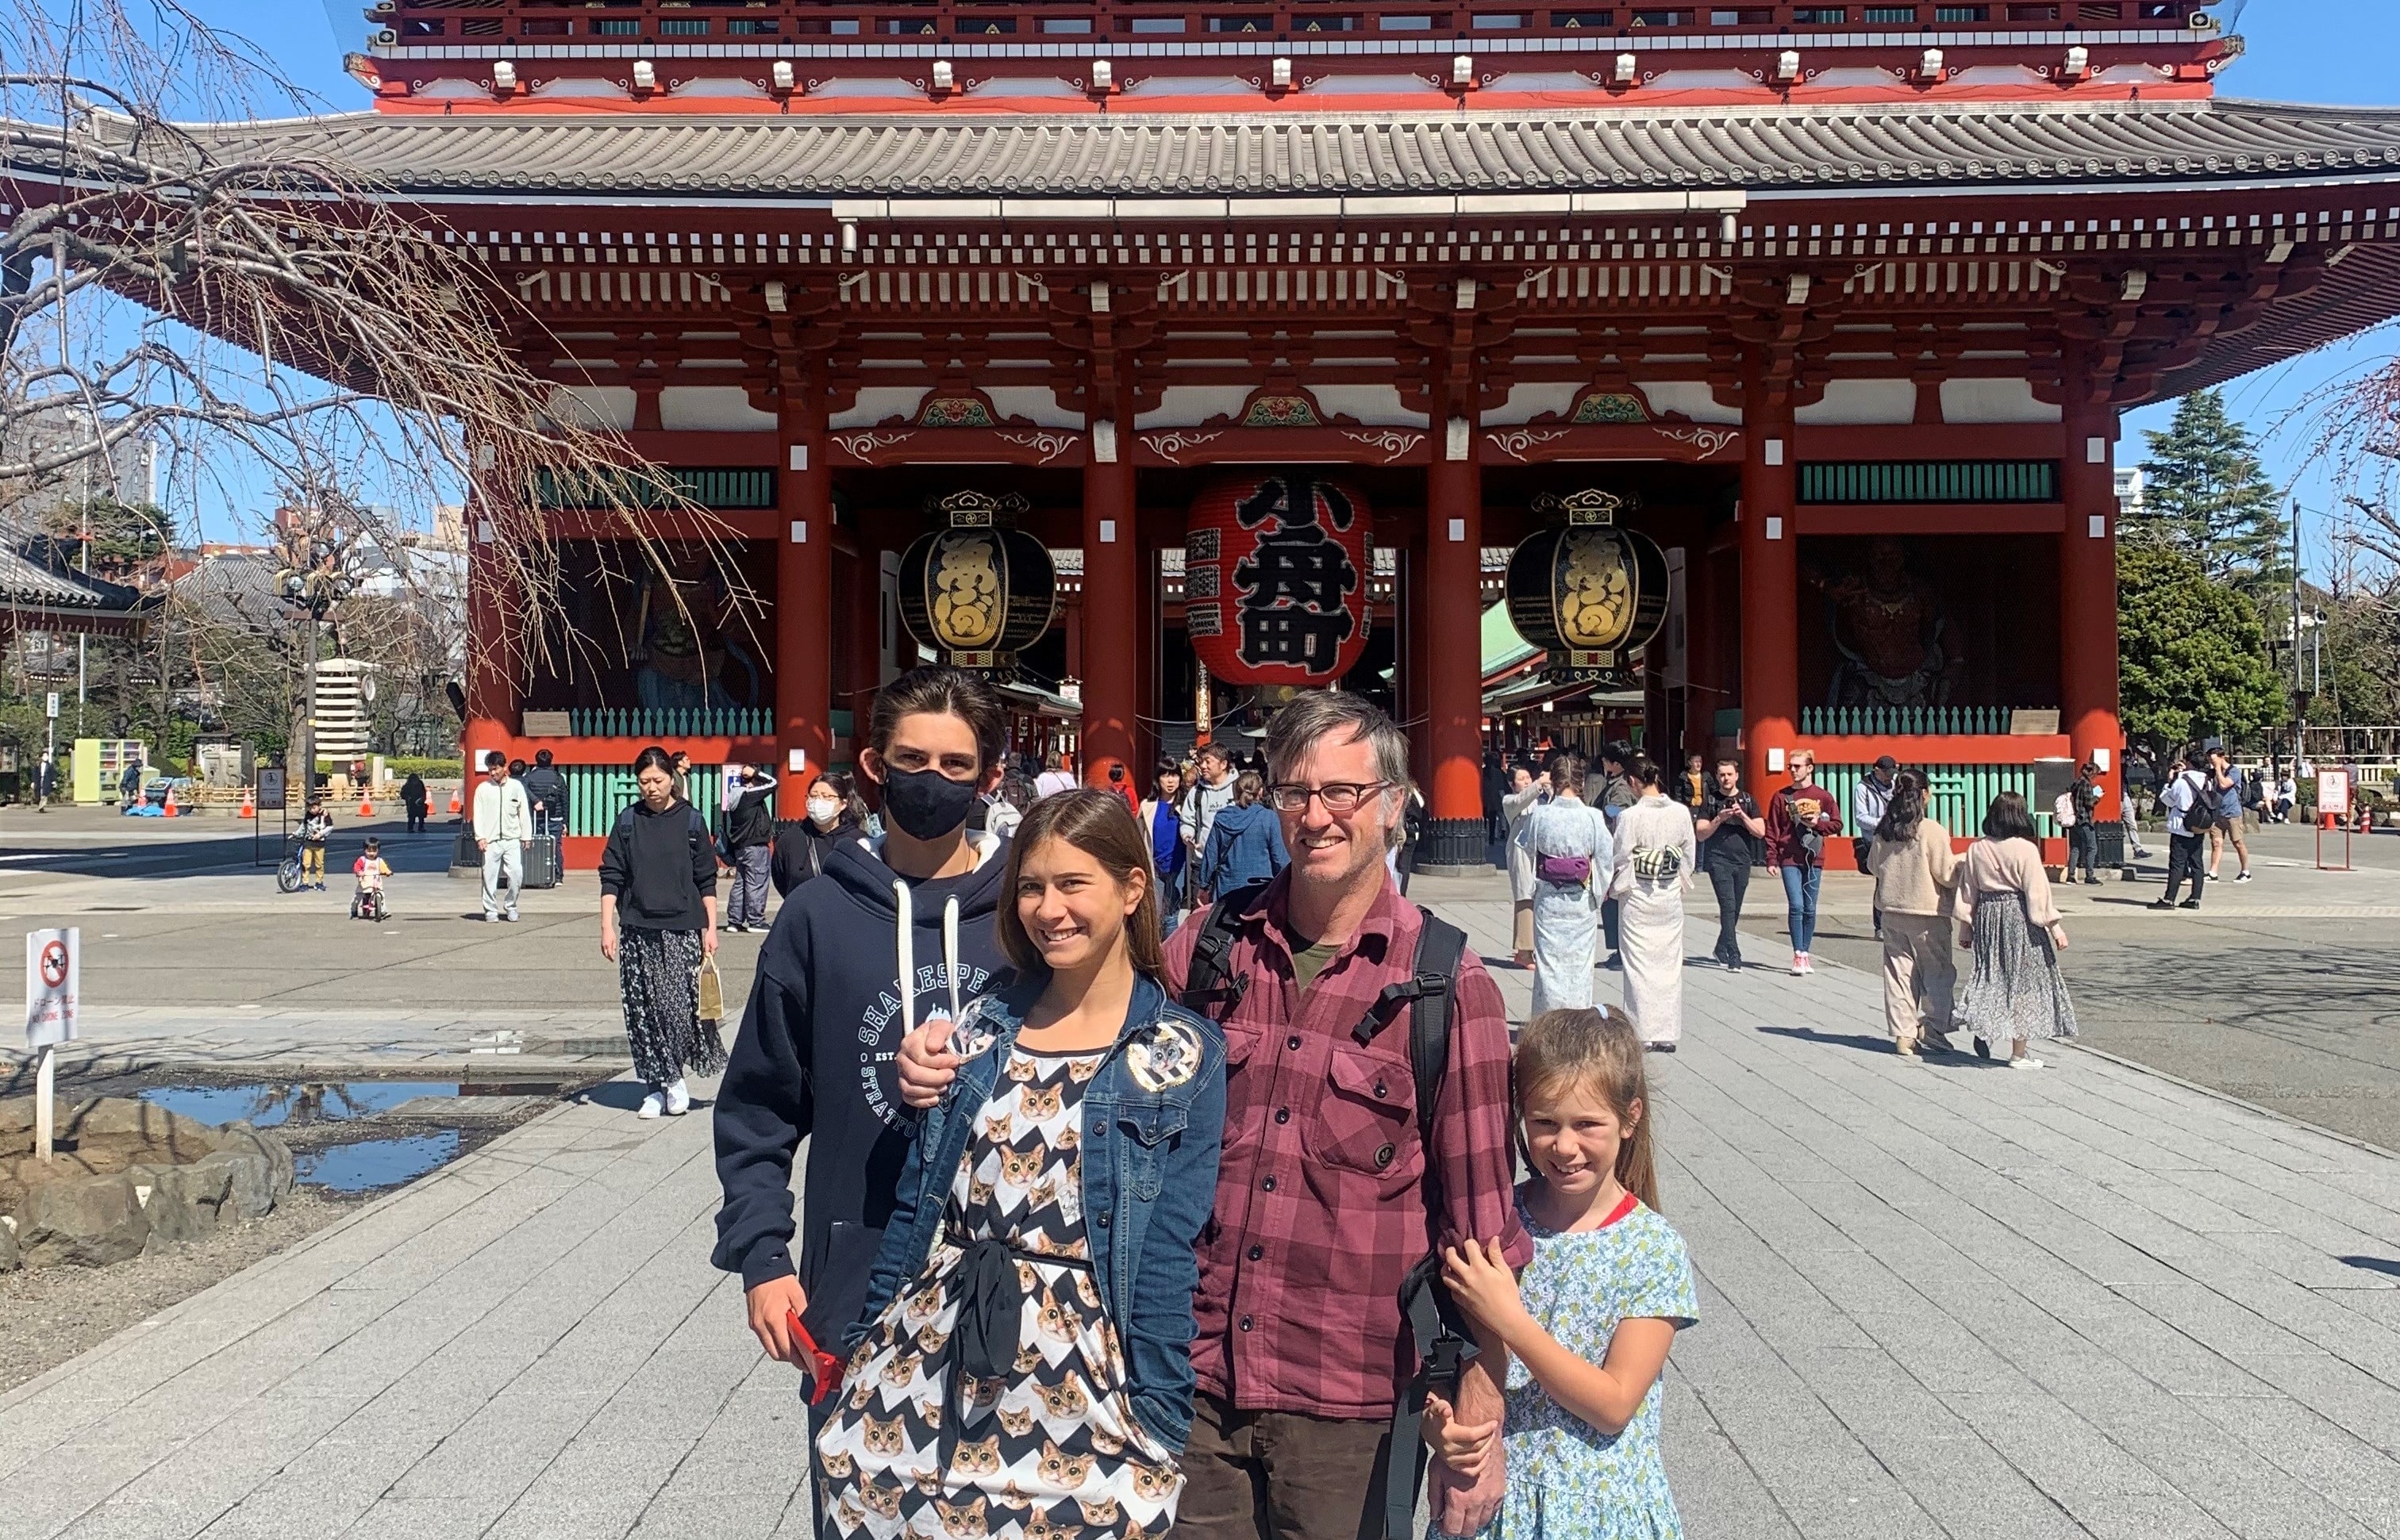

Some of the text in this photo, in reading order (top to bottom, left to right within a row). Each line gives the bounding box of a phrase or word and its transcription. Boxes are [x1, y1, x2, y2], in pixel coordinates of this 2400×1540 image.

[1233, 476, 1357, 674] 小舟町
[875, 1052, 897, 1062] EST.
